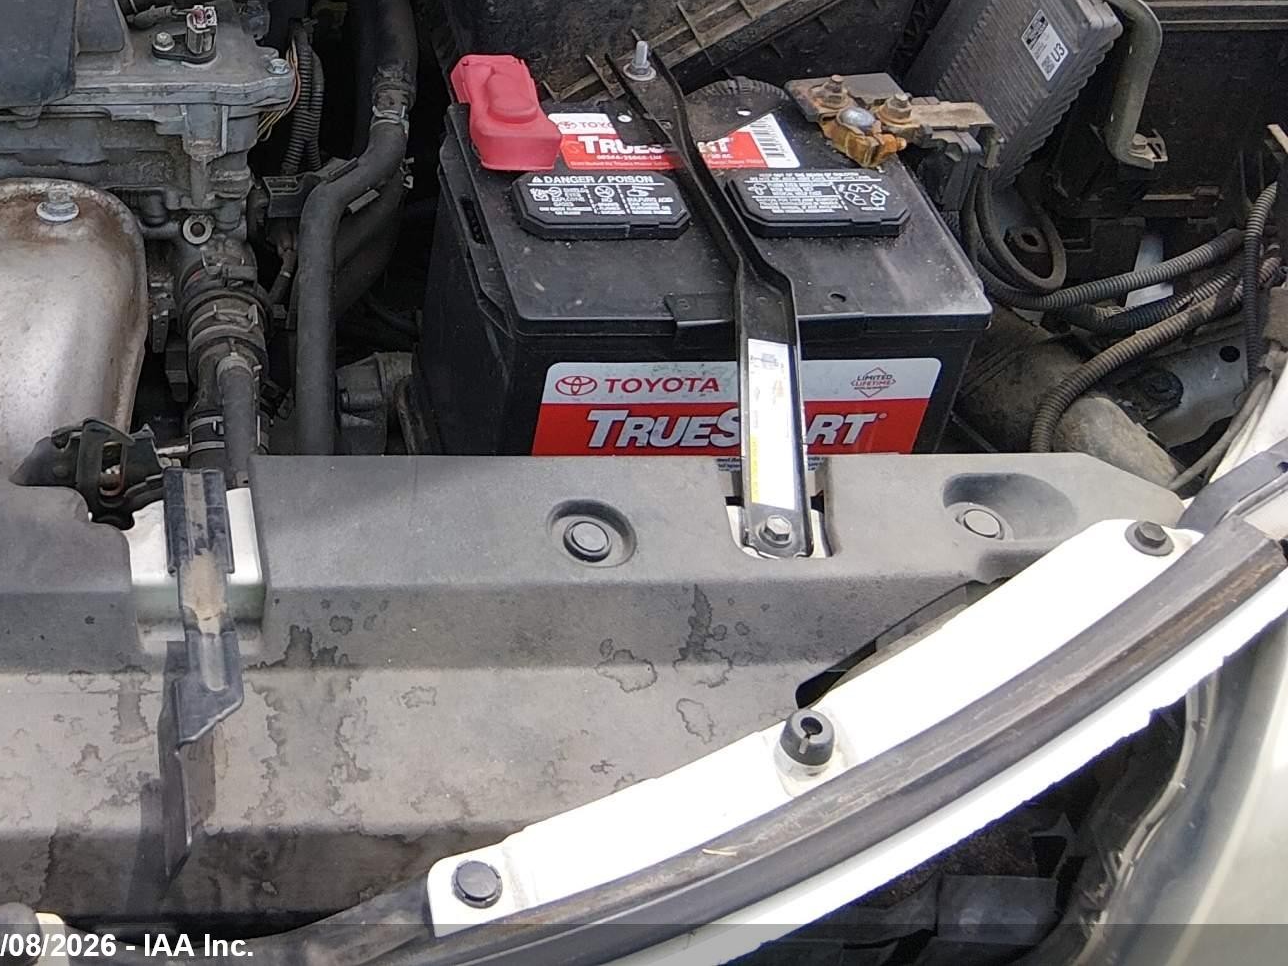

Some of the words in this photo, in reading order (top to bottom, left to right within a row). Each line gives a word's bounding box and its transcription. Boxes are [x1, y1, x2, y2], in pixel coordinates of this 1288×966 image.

[1049, 42, 1065, 63] U3
[580, 121, 614, 129] TOYO
[543, 175, 595, 184] DANGER
[606, 175, 654, 183] POISON
[605, 377, 720, 393] TOYOTA
